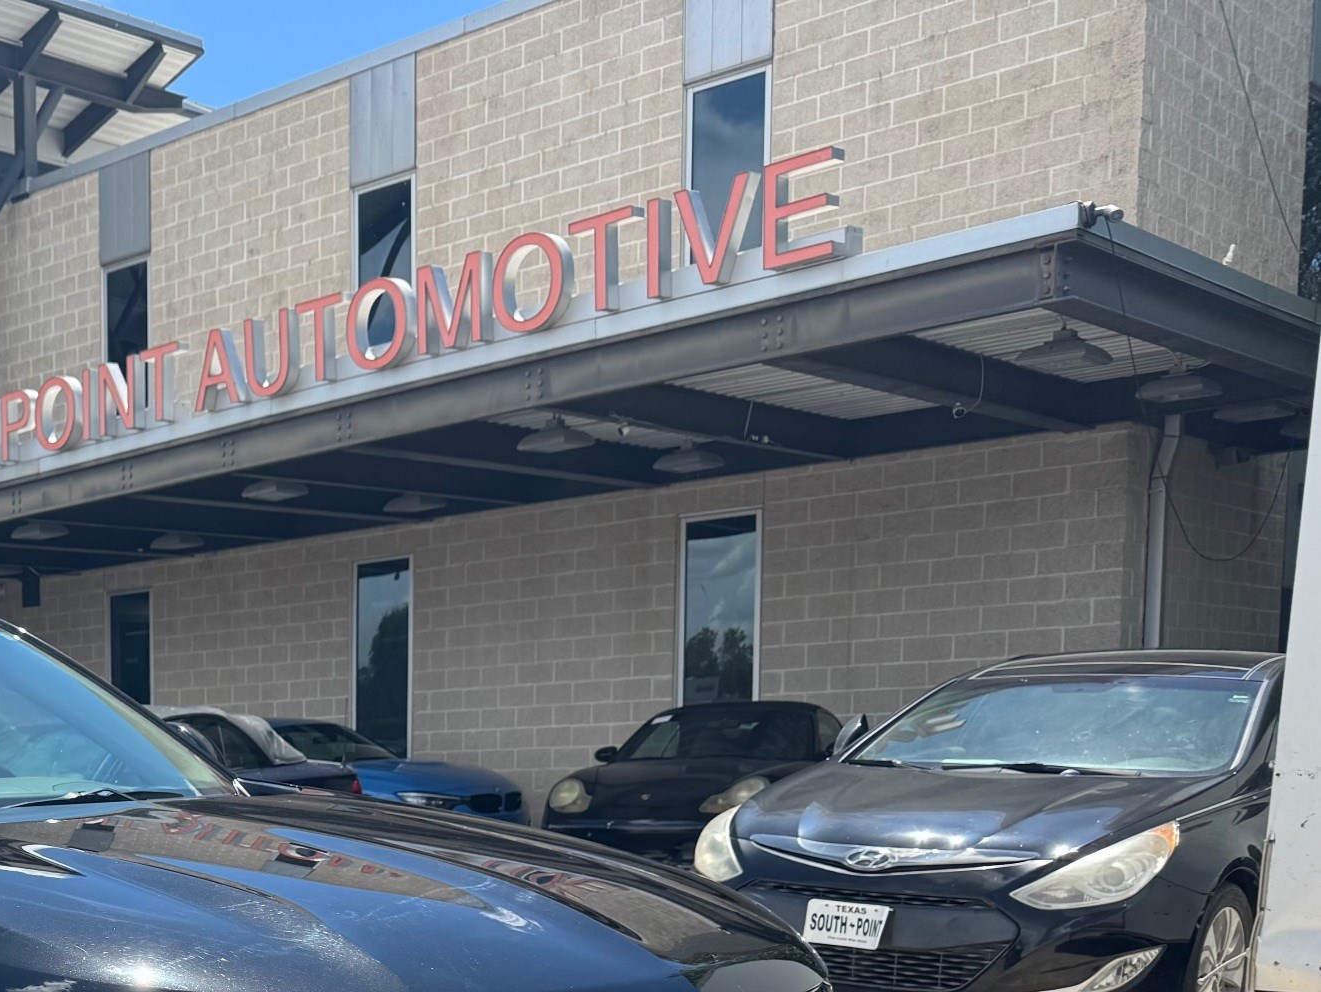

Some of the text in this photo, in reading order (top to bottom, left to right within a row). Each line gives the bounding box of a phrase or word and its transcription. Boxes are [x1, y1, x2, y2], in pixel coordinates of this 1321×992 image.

[194, 145, 845, 412] AUTOMOTIVE
[836, 905, 867, 915] TEXAS
[810, 913, 883, 938] SOUTH POINT
